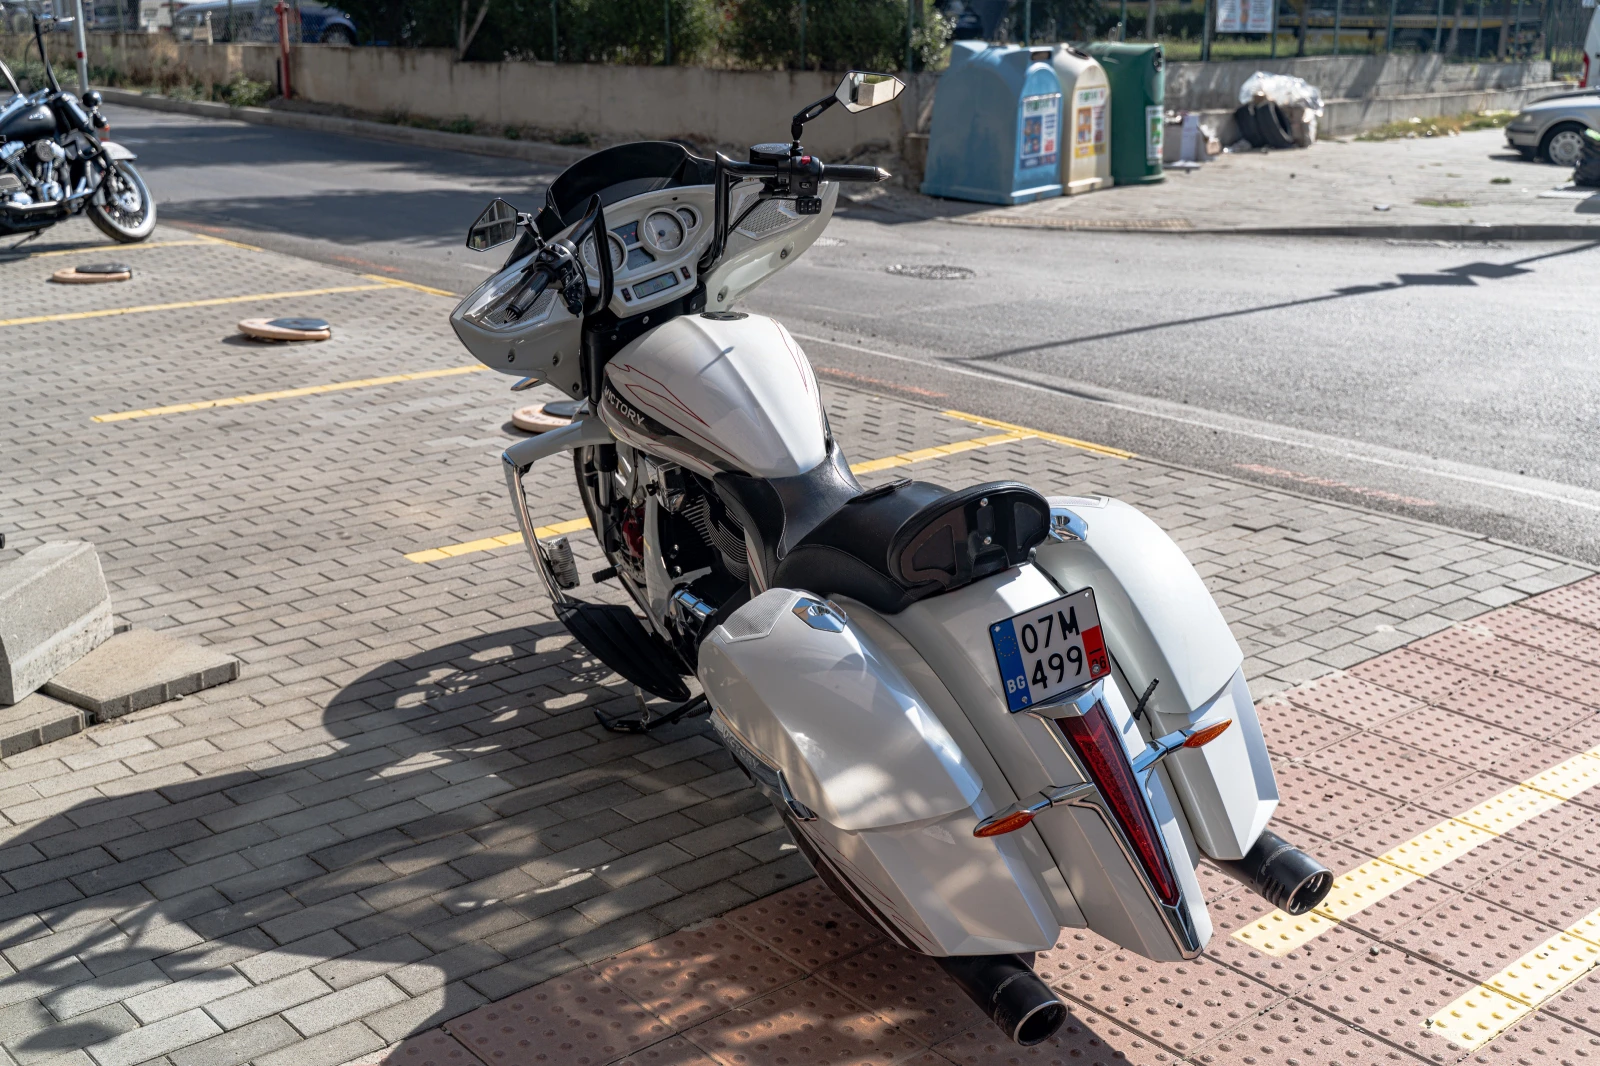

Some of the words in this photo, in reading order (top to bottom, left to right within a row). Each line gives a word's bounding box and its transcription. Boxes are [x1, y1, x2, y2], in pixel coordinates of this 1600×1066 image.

[604, 386, 645, 425] VICTORY
[1021, 606, 1080, 653] 07M
[1006, 675, 1026, 694] BG
[1032, 645, 1083, 689] 499
